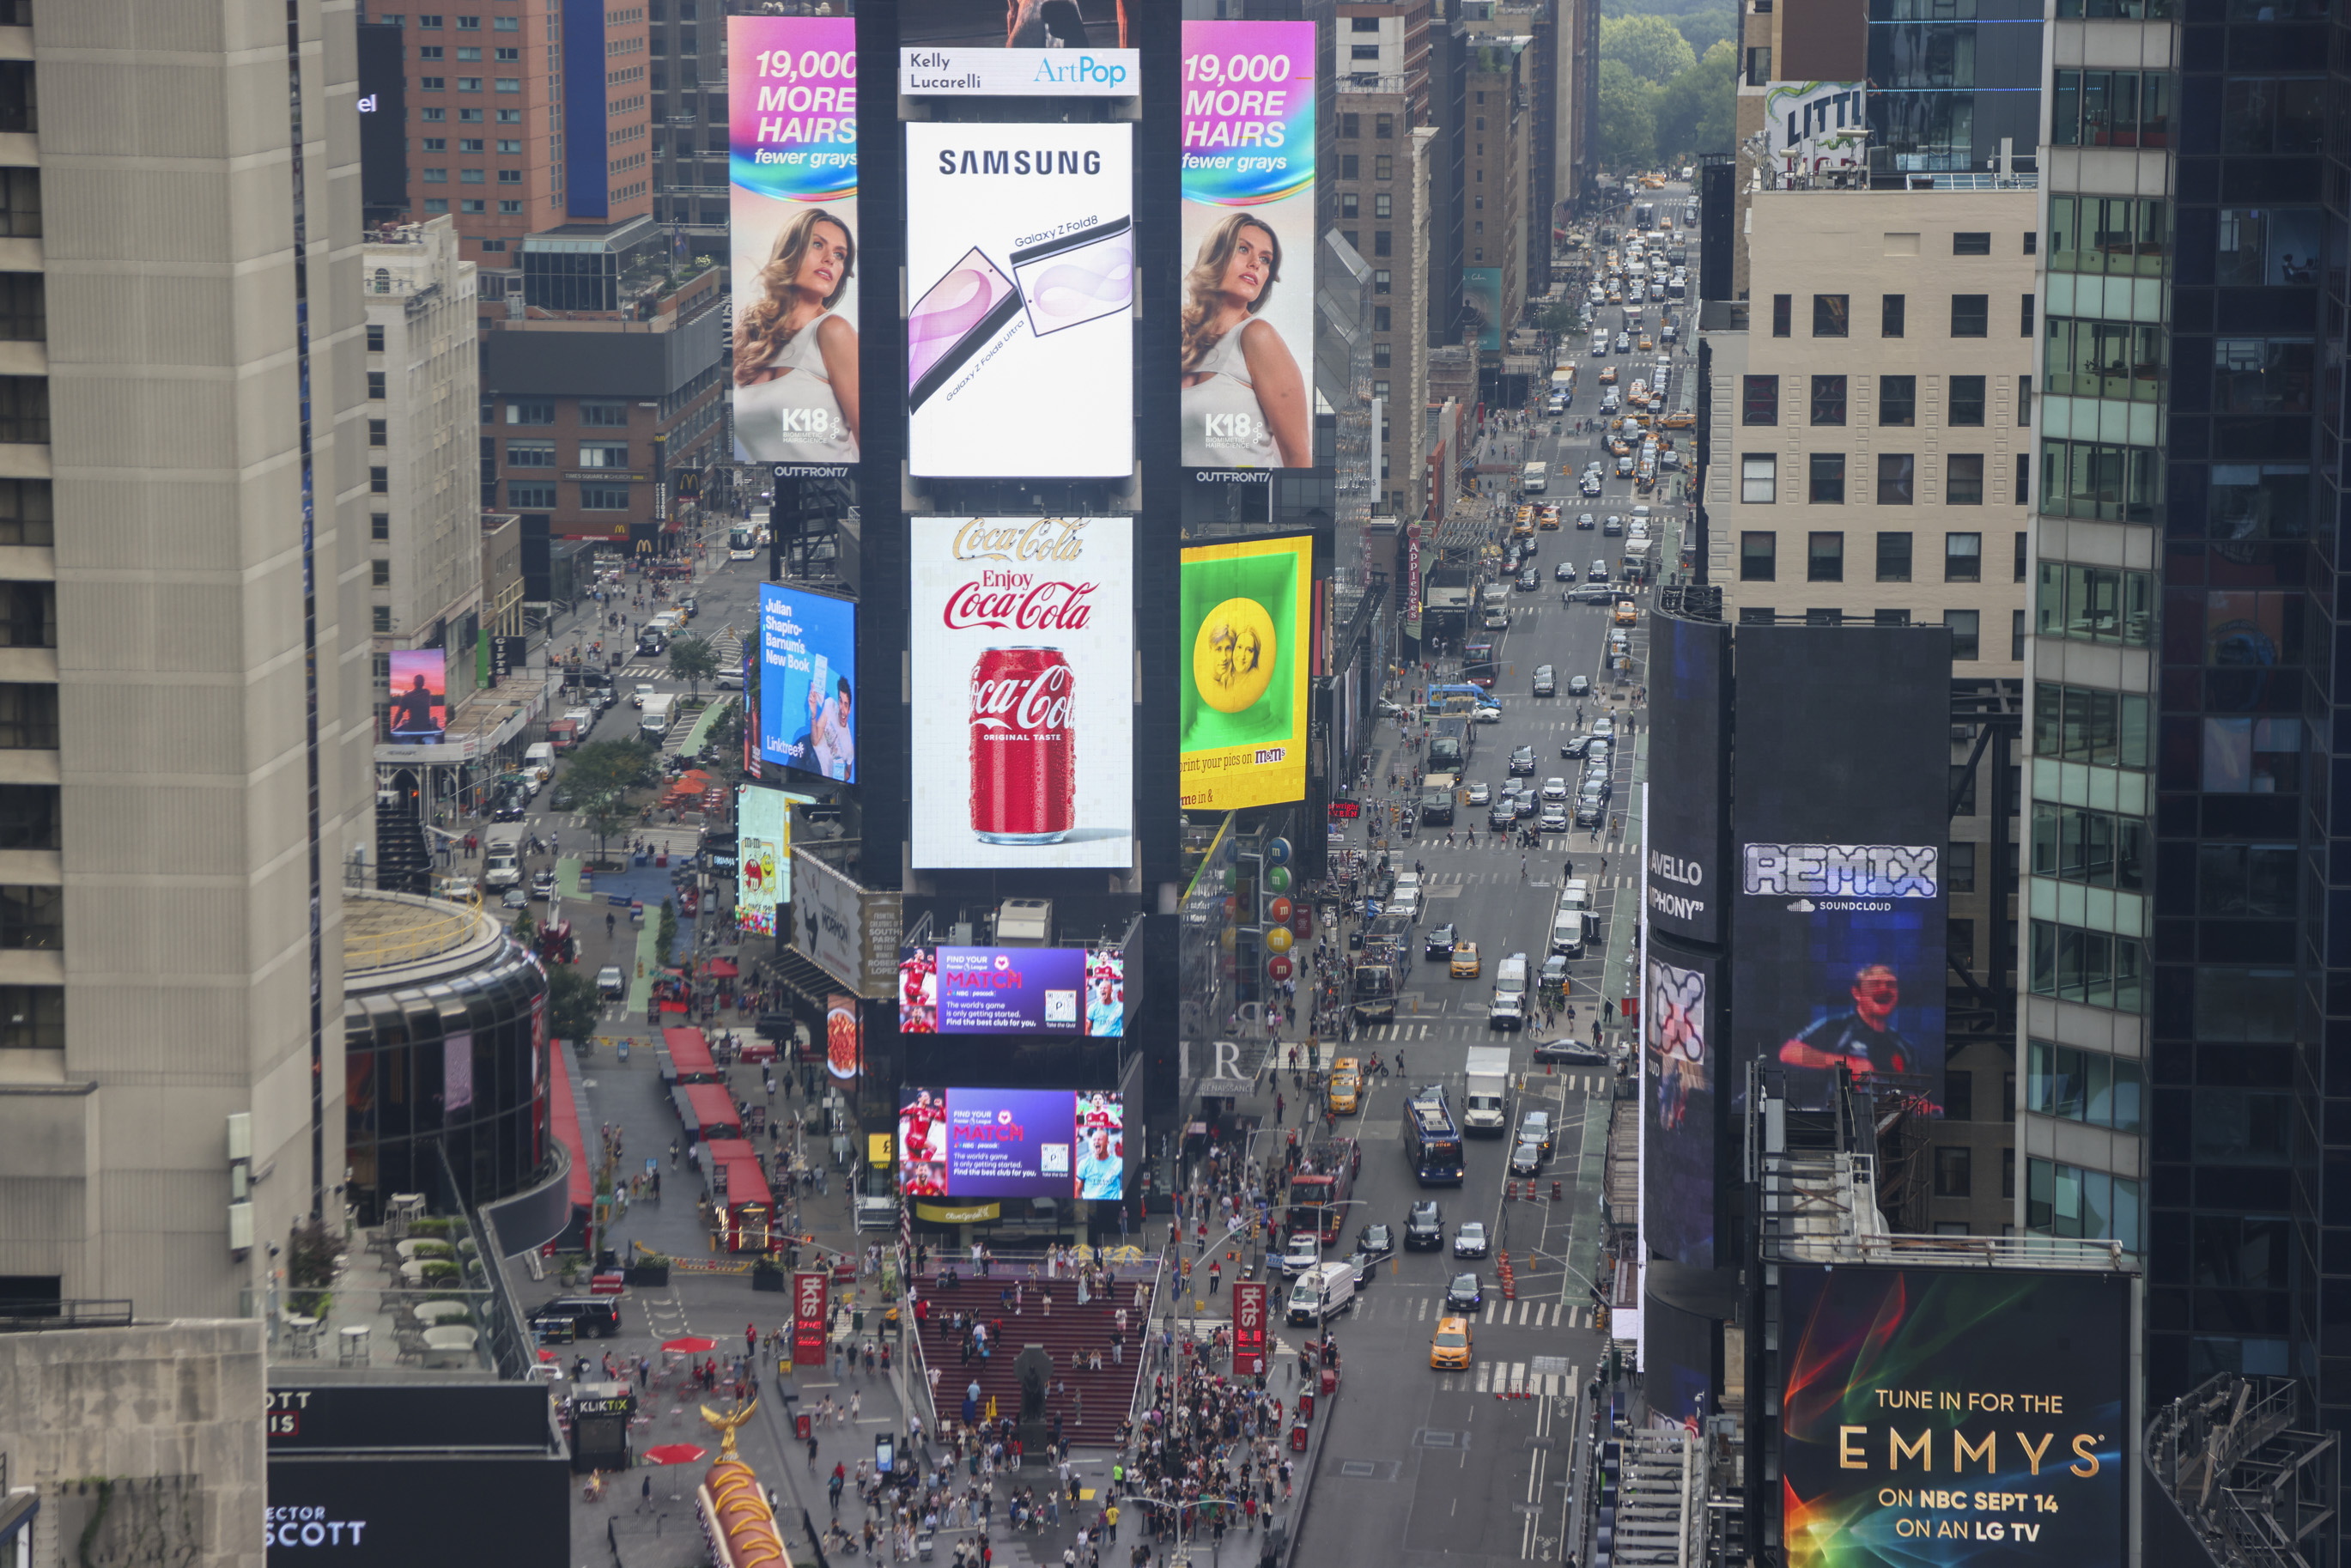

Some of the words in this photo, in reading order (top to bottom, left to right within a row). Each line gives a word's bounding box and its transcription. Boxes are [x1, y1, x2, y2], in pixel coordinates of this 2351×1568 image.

[756, 50, 856, 83] 19,000
[910, 52, 951, 71] Kelly
[1033, 56, 1127, 88] ArtPop
[1184, 53, 1290, 87] 19,000
[910, 74, 981, 88] Lucarelli
[756, 86, 856, 112] MORE
[1185, 89, 1286, 116] MORE
[756, 117, 856, 143] HAIRS
[1184, 121, 1285, 148] HAIRS
[755, 148, 807, 165] fewer
[810, 152, 857, 168] grays
[939, 149, 1101, 175] SAMSUNG
[1182, 152, 1234, 168] fewer
[1237, 155, 1286, 173] grays
[1014, 228, 1056, 247] Galaxy
[1058, 225, 1065, 235] Z
[1066, 215, 1098, 233] Fold8
[946, 368, 975, 401] Galaxy
[975, 363, 981, 373] Z
[980, 341, 1004, 366] Fold8
[1003, 319, 1025, 341] Ultra
[782, 408, 828, 432] K18
[1205, 412, 1251, 437] K18
[952, 517, 1092, 562] Coca-Cola
[982, 569, 1034, 591] Enjoy
[765, 598, 792, 617] Julian
[943, 581, 1101, 630] Coca-Cola
[765, 616, 803, 636] Shapiro-
[765, 632, 805, 654] Barnum's
[495, 638, 507, 675] GIFTS
[765, 649, 787, 667] New
[787, 653, 811, 672] Book
[766, 735, 799, 757] Linktree
[1201, 758, 1223, 773] your
[1224, 752, 1241, 771] pics
[1242, 752, 1253, 764] on
[1198, 791, 1206, 804] in
[1207, 788, 1213, 803] &
[1649, 849, 1703, 886] AVELLO
[1745, 844, 1937, 896] REMIX
[1819, 902, 1892, 911] SOUNDCLOUD
[868, 959, 900, 968] ROBERT
[871, 967, 897, 975] LOPEZ
[946, 971, 1023, 989] MATCH
[952, 1010, 967, 1018] only
[968, 1010, 993, 1018] getting
[963, 1018, 975, 1026] the
[976, 1018, 992, 1026] best
[993, 1018, 1009, 1026] club
[1009, 1018, 1019, 1026] for
[1212, 1042, 1253, 1080] R
[1200, 1083, 1254, 1093] RENAISSANCE
[953, 1124, 1024, 1142] MATCH
[801, 1276, 823, 1318] tkts
[1241, 1286, 1261, 1328] tkts
[1875, 1389, 1933, 1409] TUNE
[1940, 1391, 1961, 1410] IN
[1968, 1393, 2014, 1413] FOR
[2020, 1395, 2063, 1414] THE
[1878, 1487, 1913, 1508] ON
[1920, 1489, 1968, 1510] NBC
[1974, 1492, 2028, 1513] SEPT
[2033, 1494, 2058, 1513] 14
[265, 1505, 326, 1522] ECTOR
[1896, 1518, 1930, 1538] ON
[1937, 1520, 1968, 1539] AN
[1976, 1521, 2005, 1542] LG
[2011, 1523, 2040, 1542] TV
